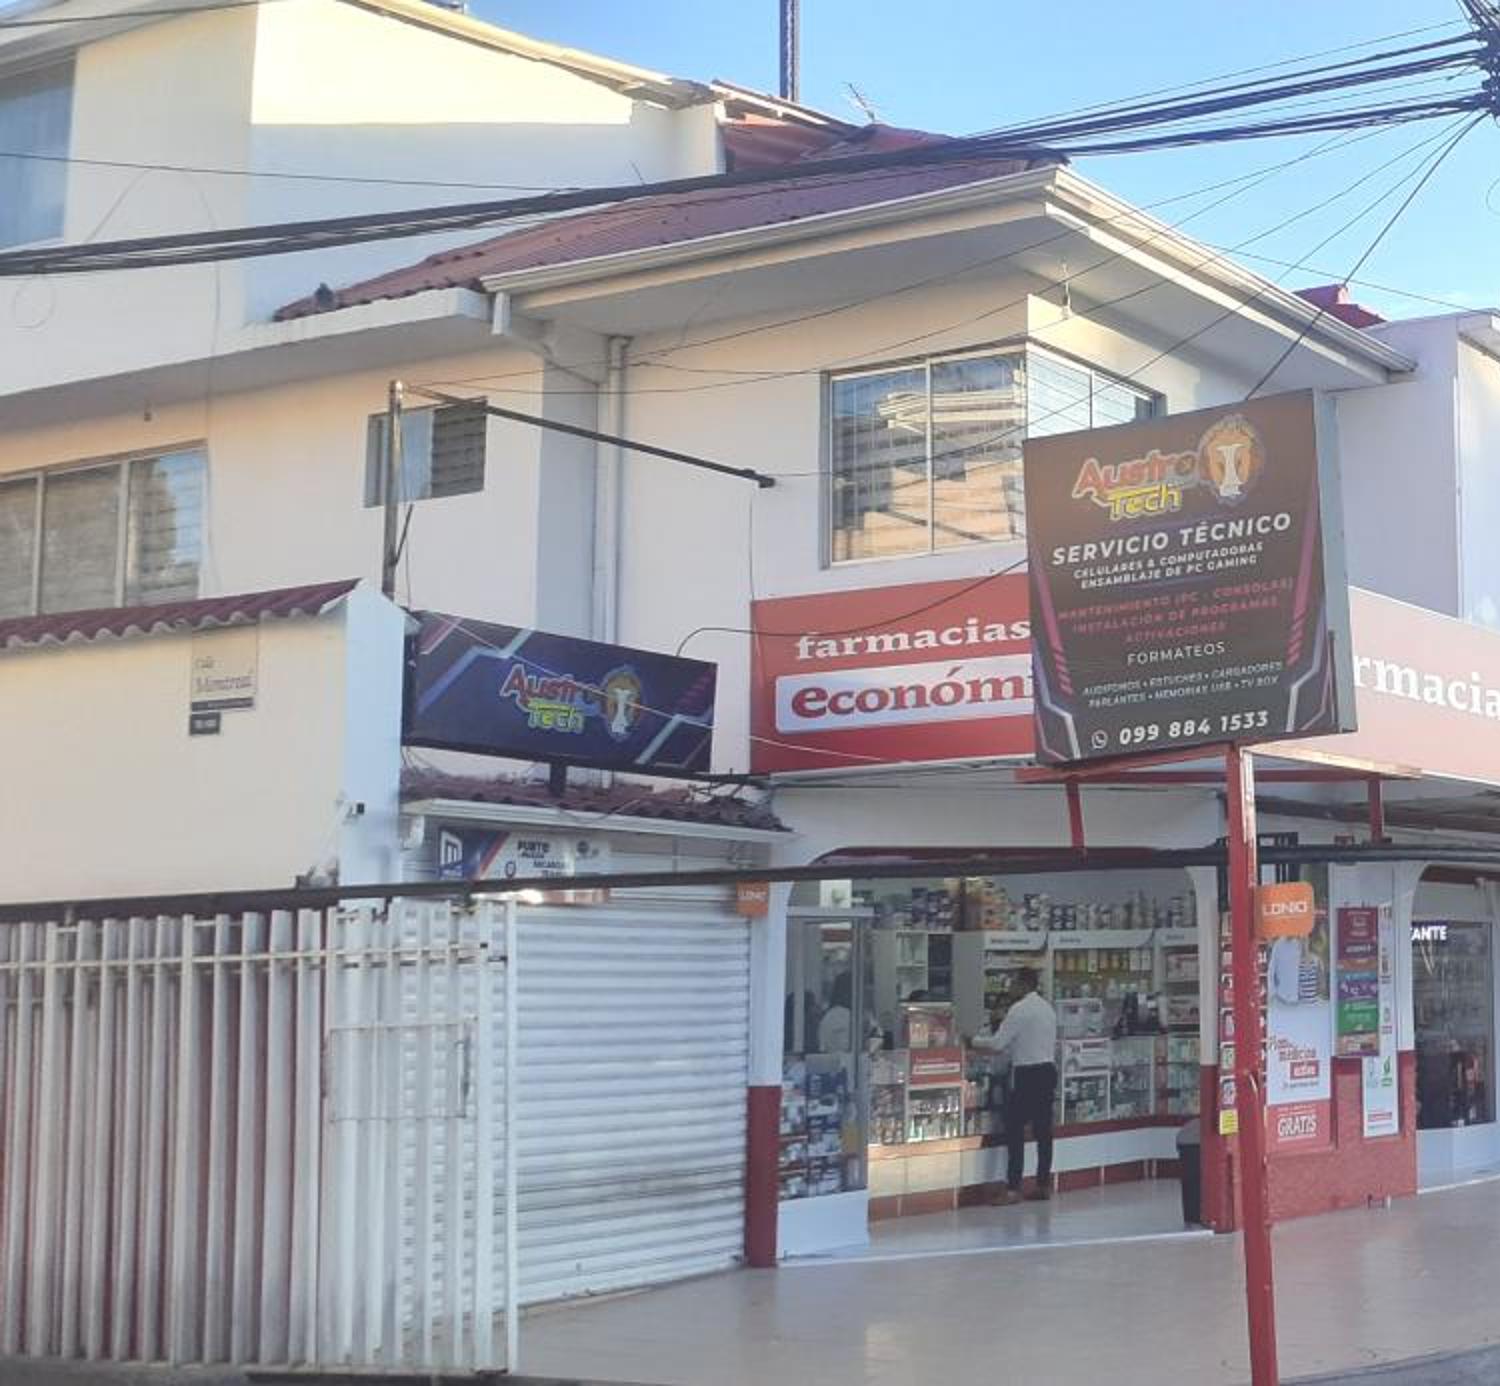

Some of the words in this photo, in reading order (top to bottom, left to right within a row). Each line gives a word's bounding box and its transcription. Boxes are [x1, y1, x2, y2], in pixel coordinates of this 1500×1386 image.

[1072, 450, 1199, 498] Austro
[1108, 483, 1182, 520] Tech
[1052, 532, 1169, 566] SERVICIO
[1180, 512, 1291, 546] TÉCNICO
[1074, 562, 1143, 579] CELULARES
[1159, 542, 1264, 567] COMPUTADORAS
[1081, 569, 1161, 589] ENSAMBLAJE
[1166, 566, 1181, 578] DE
[1186, 562, 1202, 574] PC
[1207, 554, 1257, 571] GAMING
[1057, 597, 1169, 621] MANTENIMIENTO
[1169, 610, 1185, 621] DE
[1191, 596, 1278, 617] PROGRAMAS
[795, 618, 1031, 660] farmacias
[1127, 641, 1226, 665] FORMATEOS
[791, 666, 1034, 718] económ
[1119, 724, 1160, 745] 099
[1168, 718, 1211, 739] 884
[1220, 710, 1269, 732] 1533
[1409, 925, 1448, 941] ANTE
[1277, 1114, 1318, 1138] GRATIS
